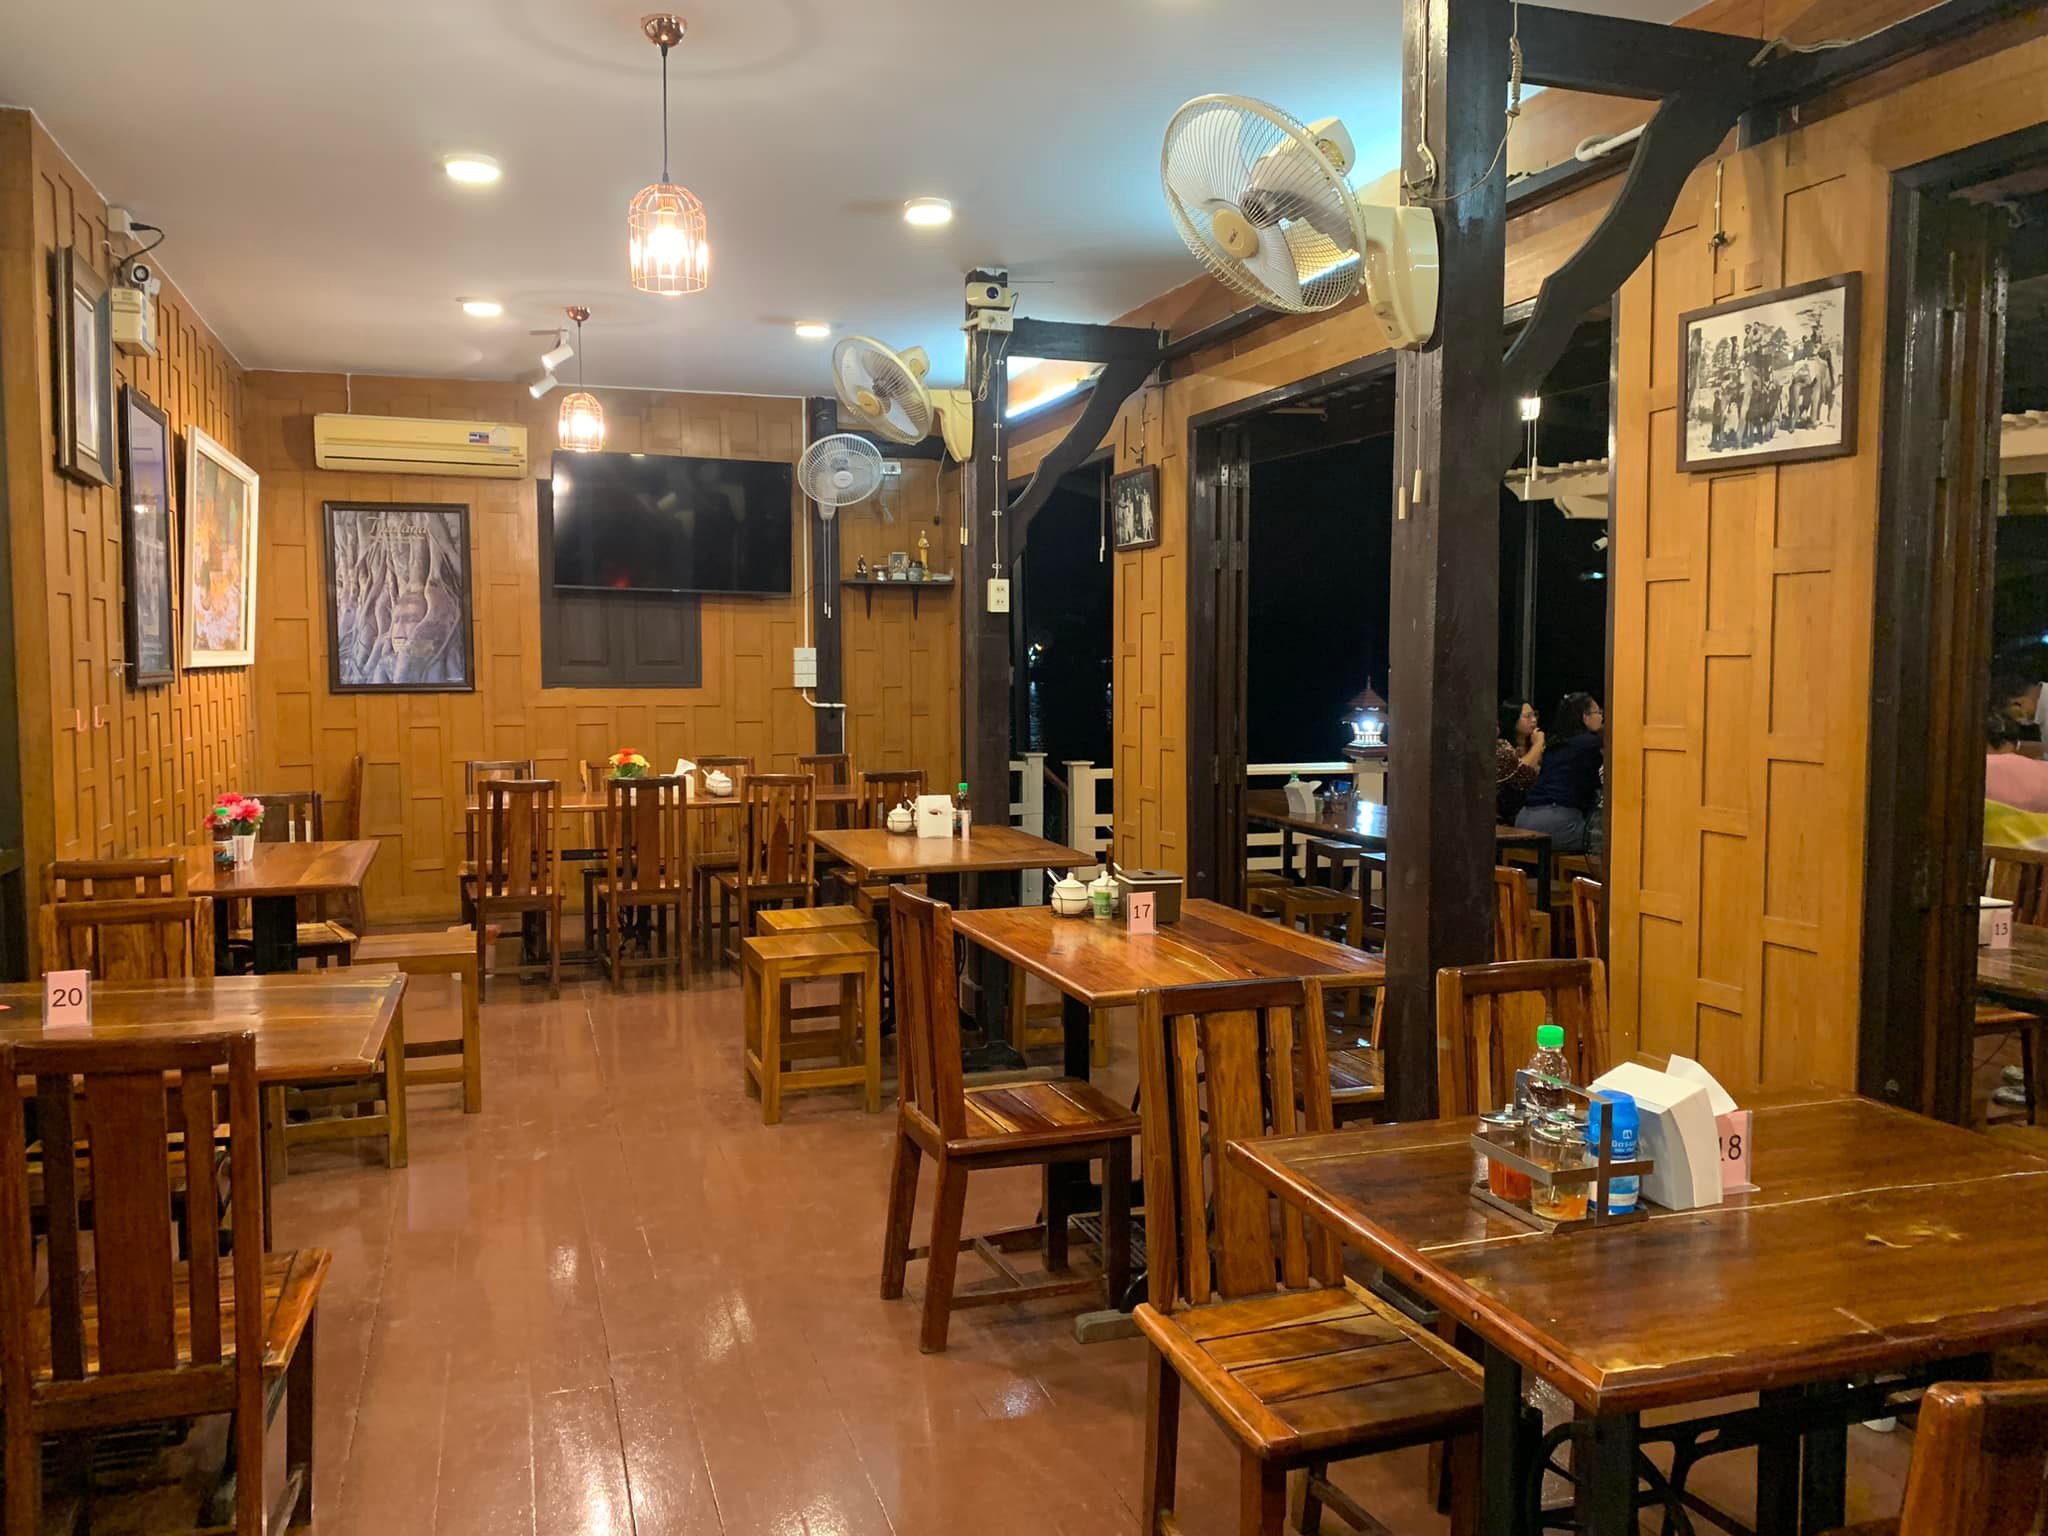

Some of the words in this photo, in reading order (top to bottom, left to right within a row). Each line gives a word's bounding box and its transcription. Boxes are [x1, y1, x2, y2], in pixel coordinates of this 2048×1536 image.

[1133, 903, 1151, 919] 17
[1994, 922, 2009, 936] 13
[52, 987, 83, 1007] 20
